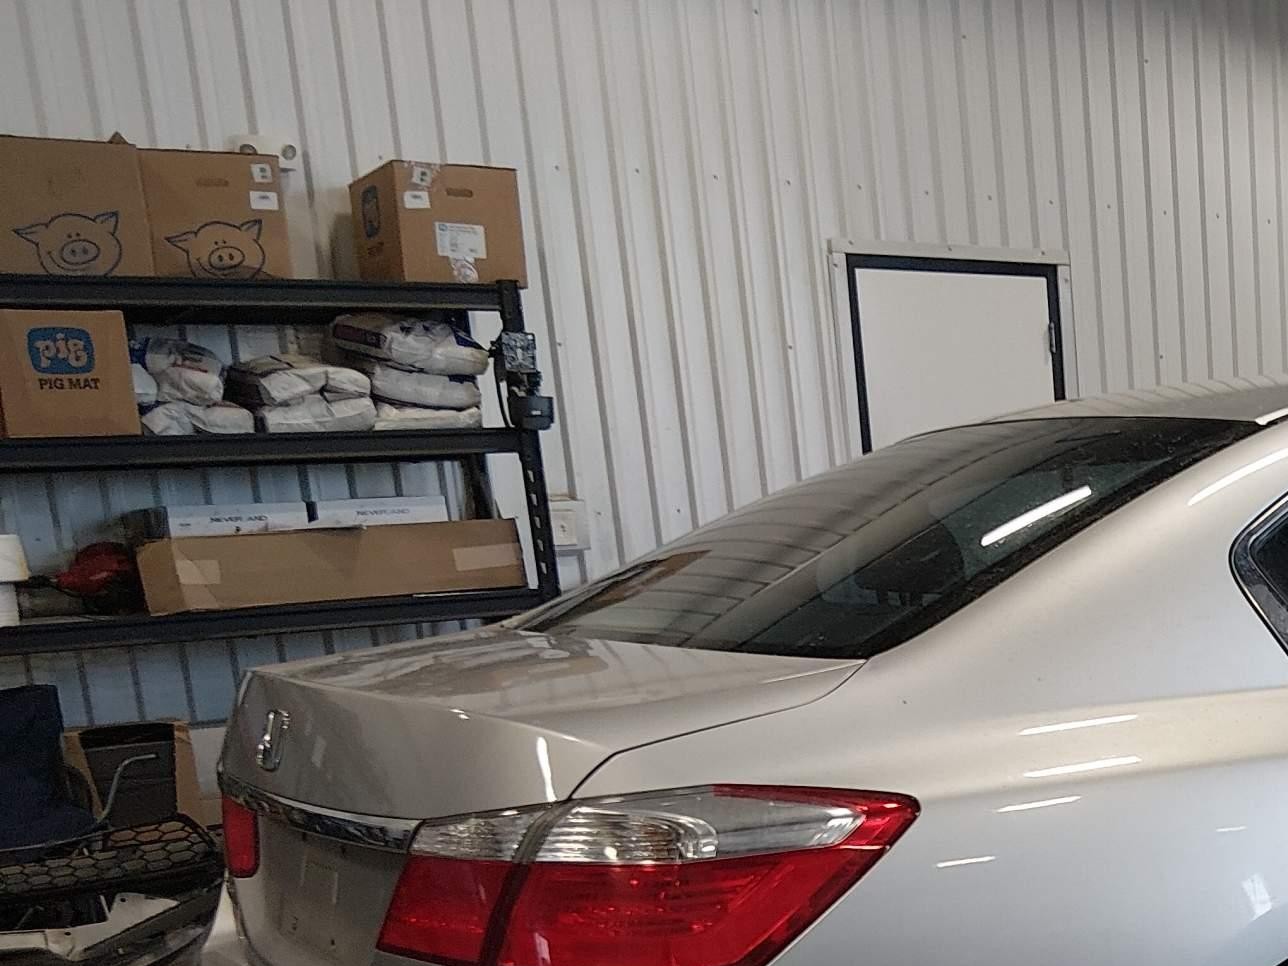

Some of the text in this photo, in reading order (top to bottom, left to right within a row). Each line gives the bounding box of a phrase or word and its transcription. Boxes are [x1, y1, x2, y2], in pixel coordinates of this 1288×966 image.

[34, 332, 89, 368] pig
[38, 378, 101, 390] PIG MAT
[353, 507, 411, 517] NEVERAND
[208, 514, 269, 523] NEVERAND
